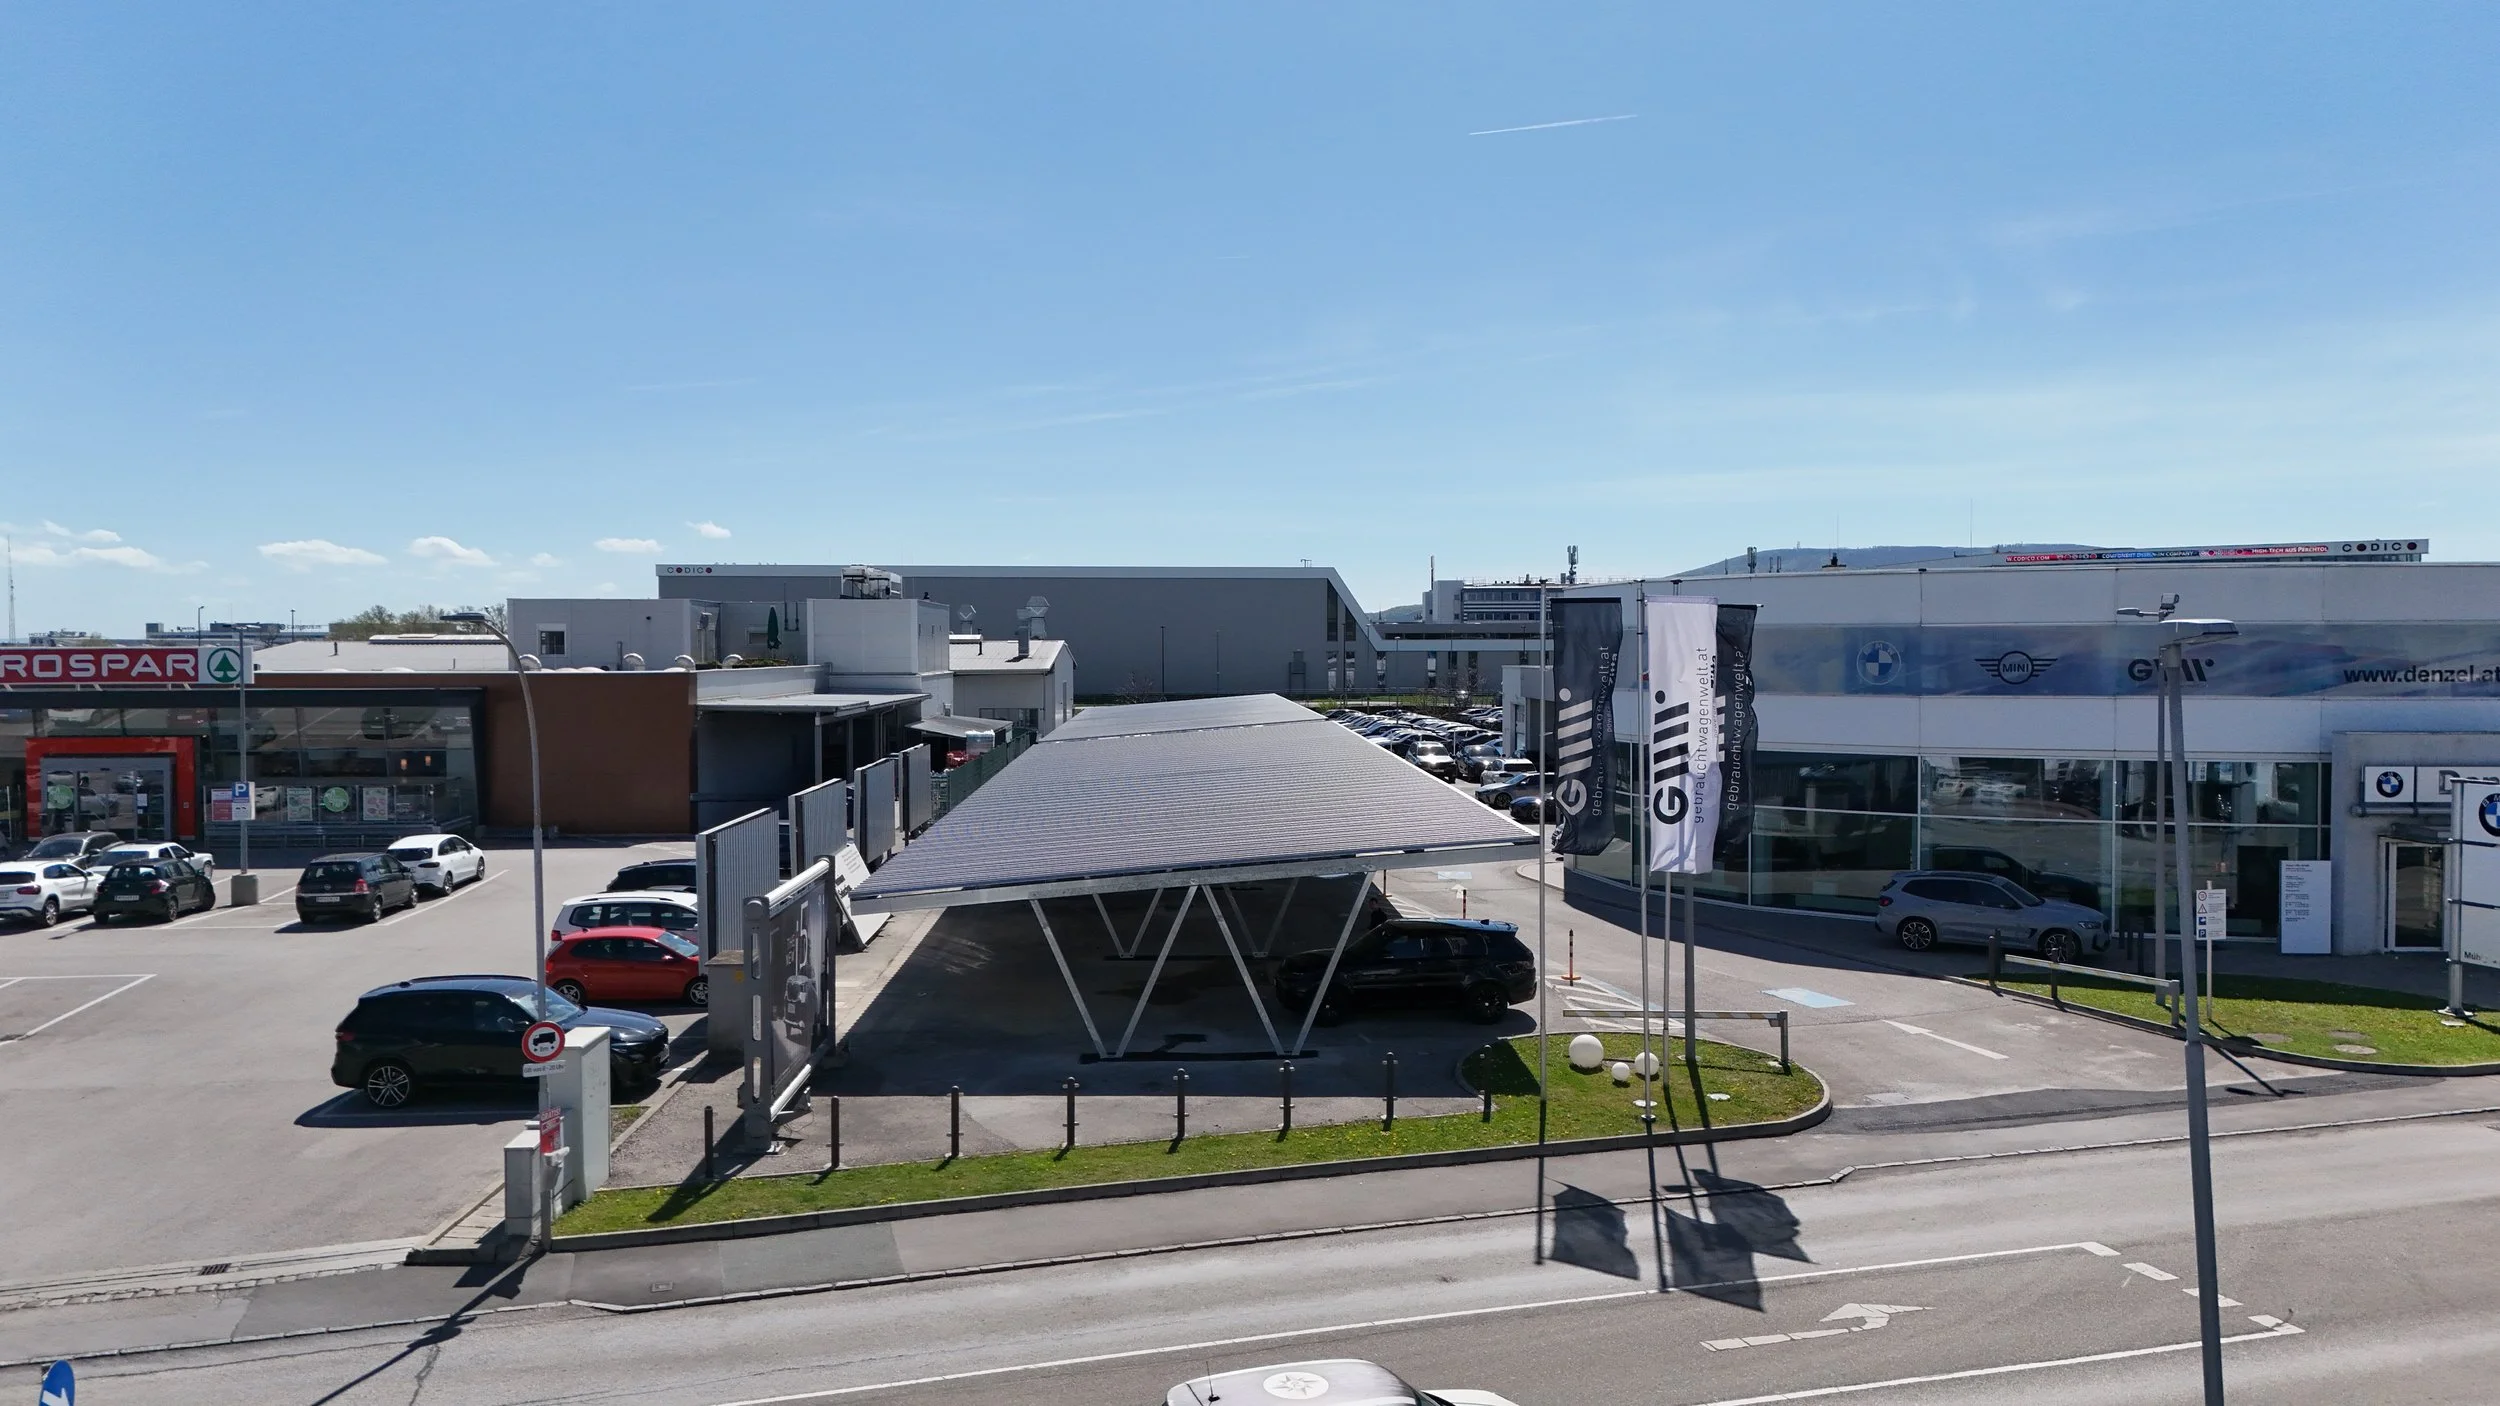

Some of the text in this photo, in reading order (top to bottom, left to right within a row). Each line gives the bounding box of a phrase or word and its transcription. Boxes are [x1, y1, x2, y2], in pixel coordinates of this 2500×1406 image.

[2342, 541, 2417, 552] CODICO
[2002, 664, 2029, 672] MINI
[2344, 665, 2500, 682] www.denzel.at
[1694, 647, 1711, 823] gebrauchtwagenwelt.at
[1727, 646, 1745, 811] gebrauchtwagenwelt.a
